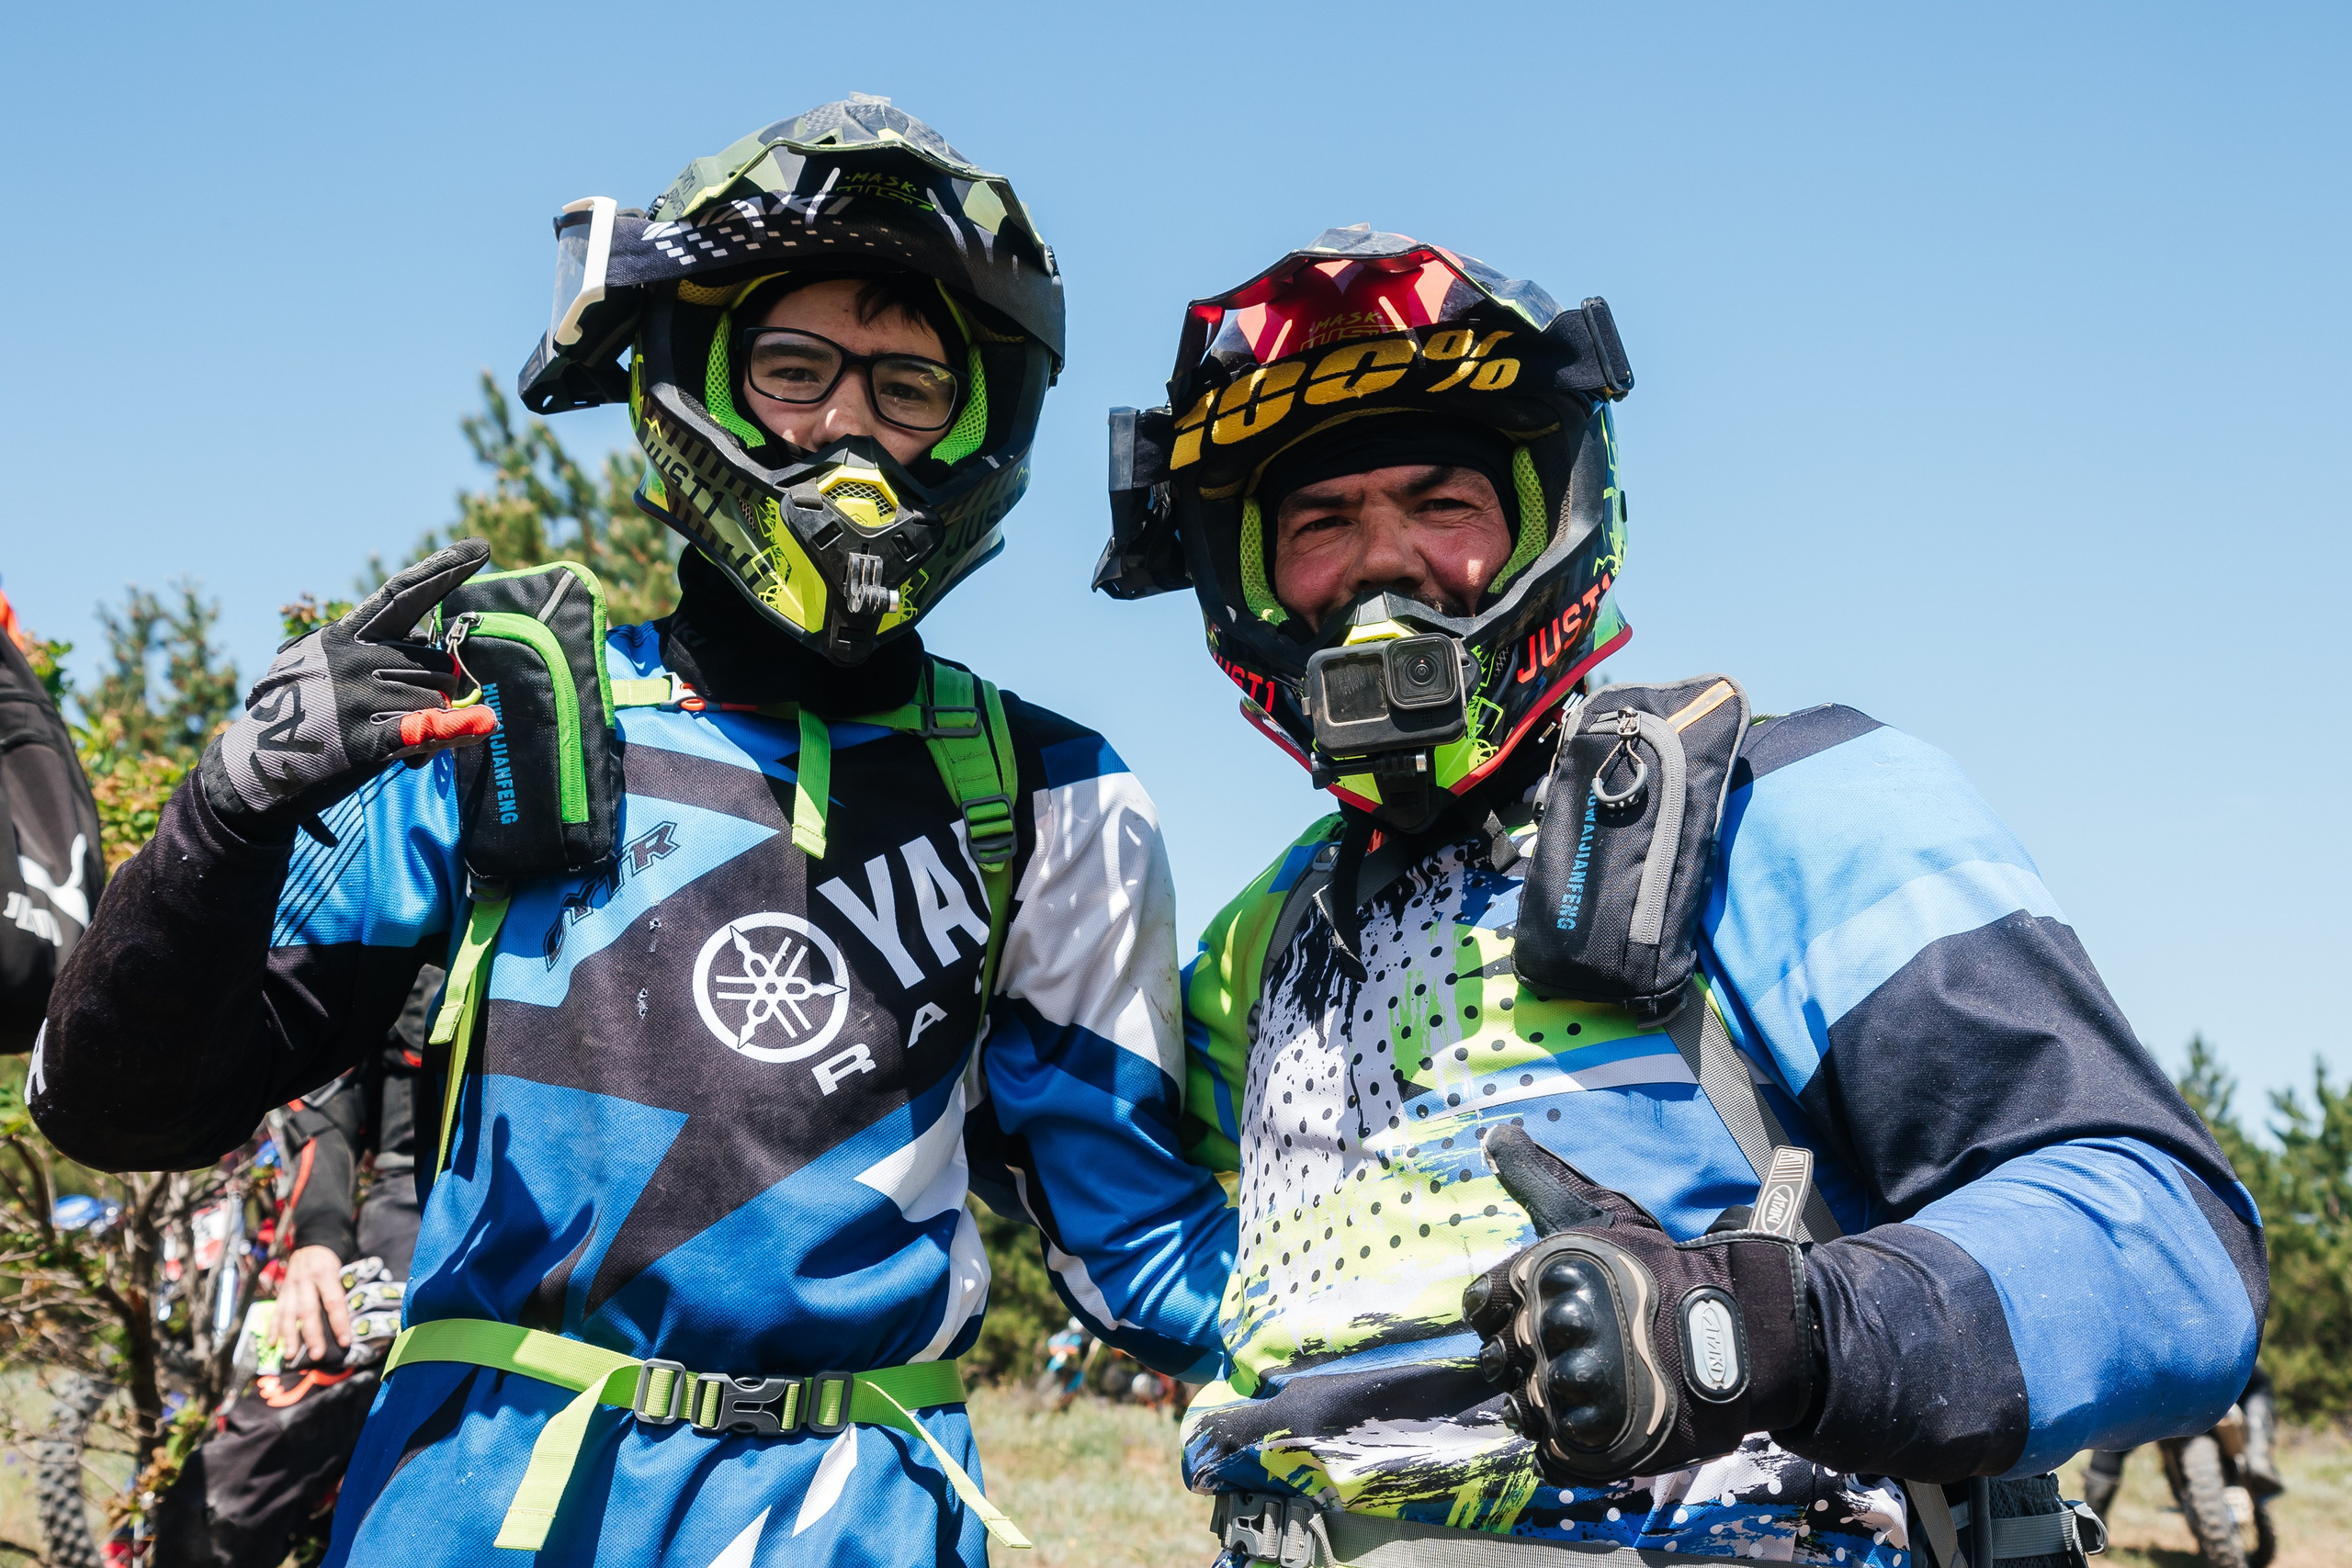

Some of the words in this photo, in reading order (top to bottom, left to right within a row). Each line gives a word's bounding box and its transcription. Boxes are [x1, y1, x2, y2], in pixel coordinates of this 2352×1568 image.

[1170, 328, 1521, 471] 100%
[481, 682, 519, 825] HUIJIANFENG
[815, 818, 992, 990] YA
